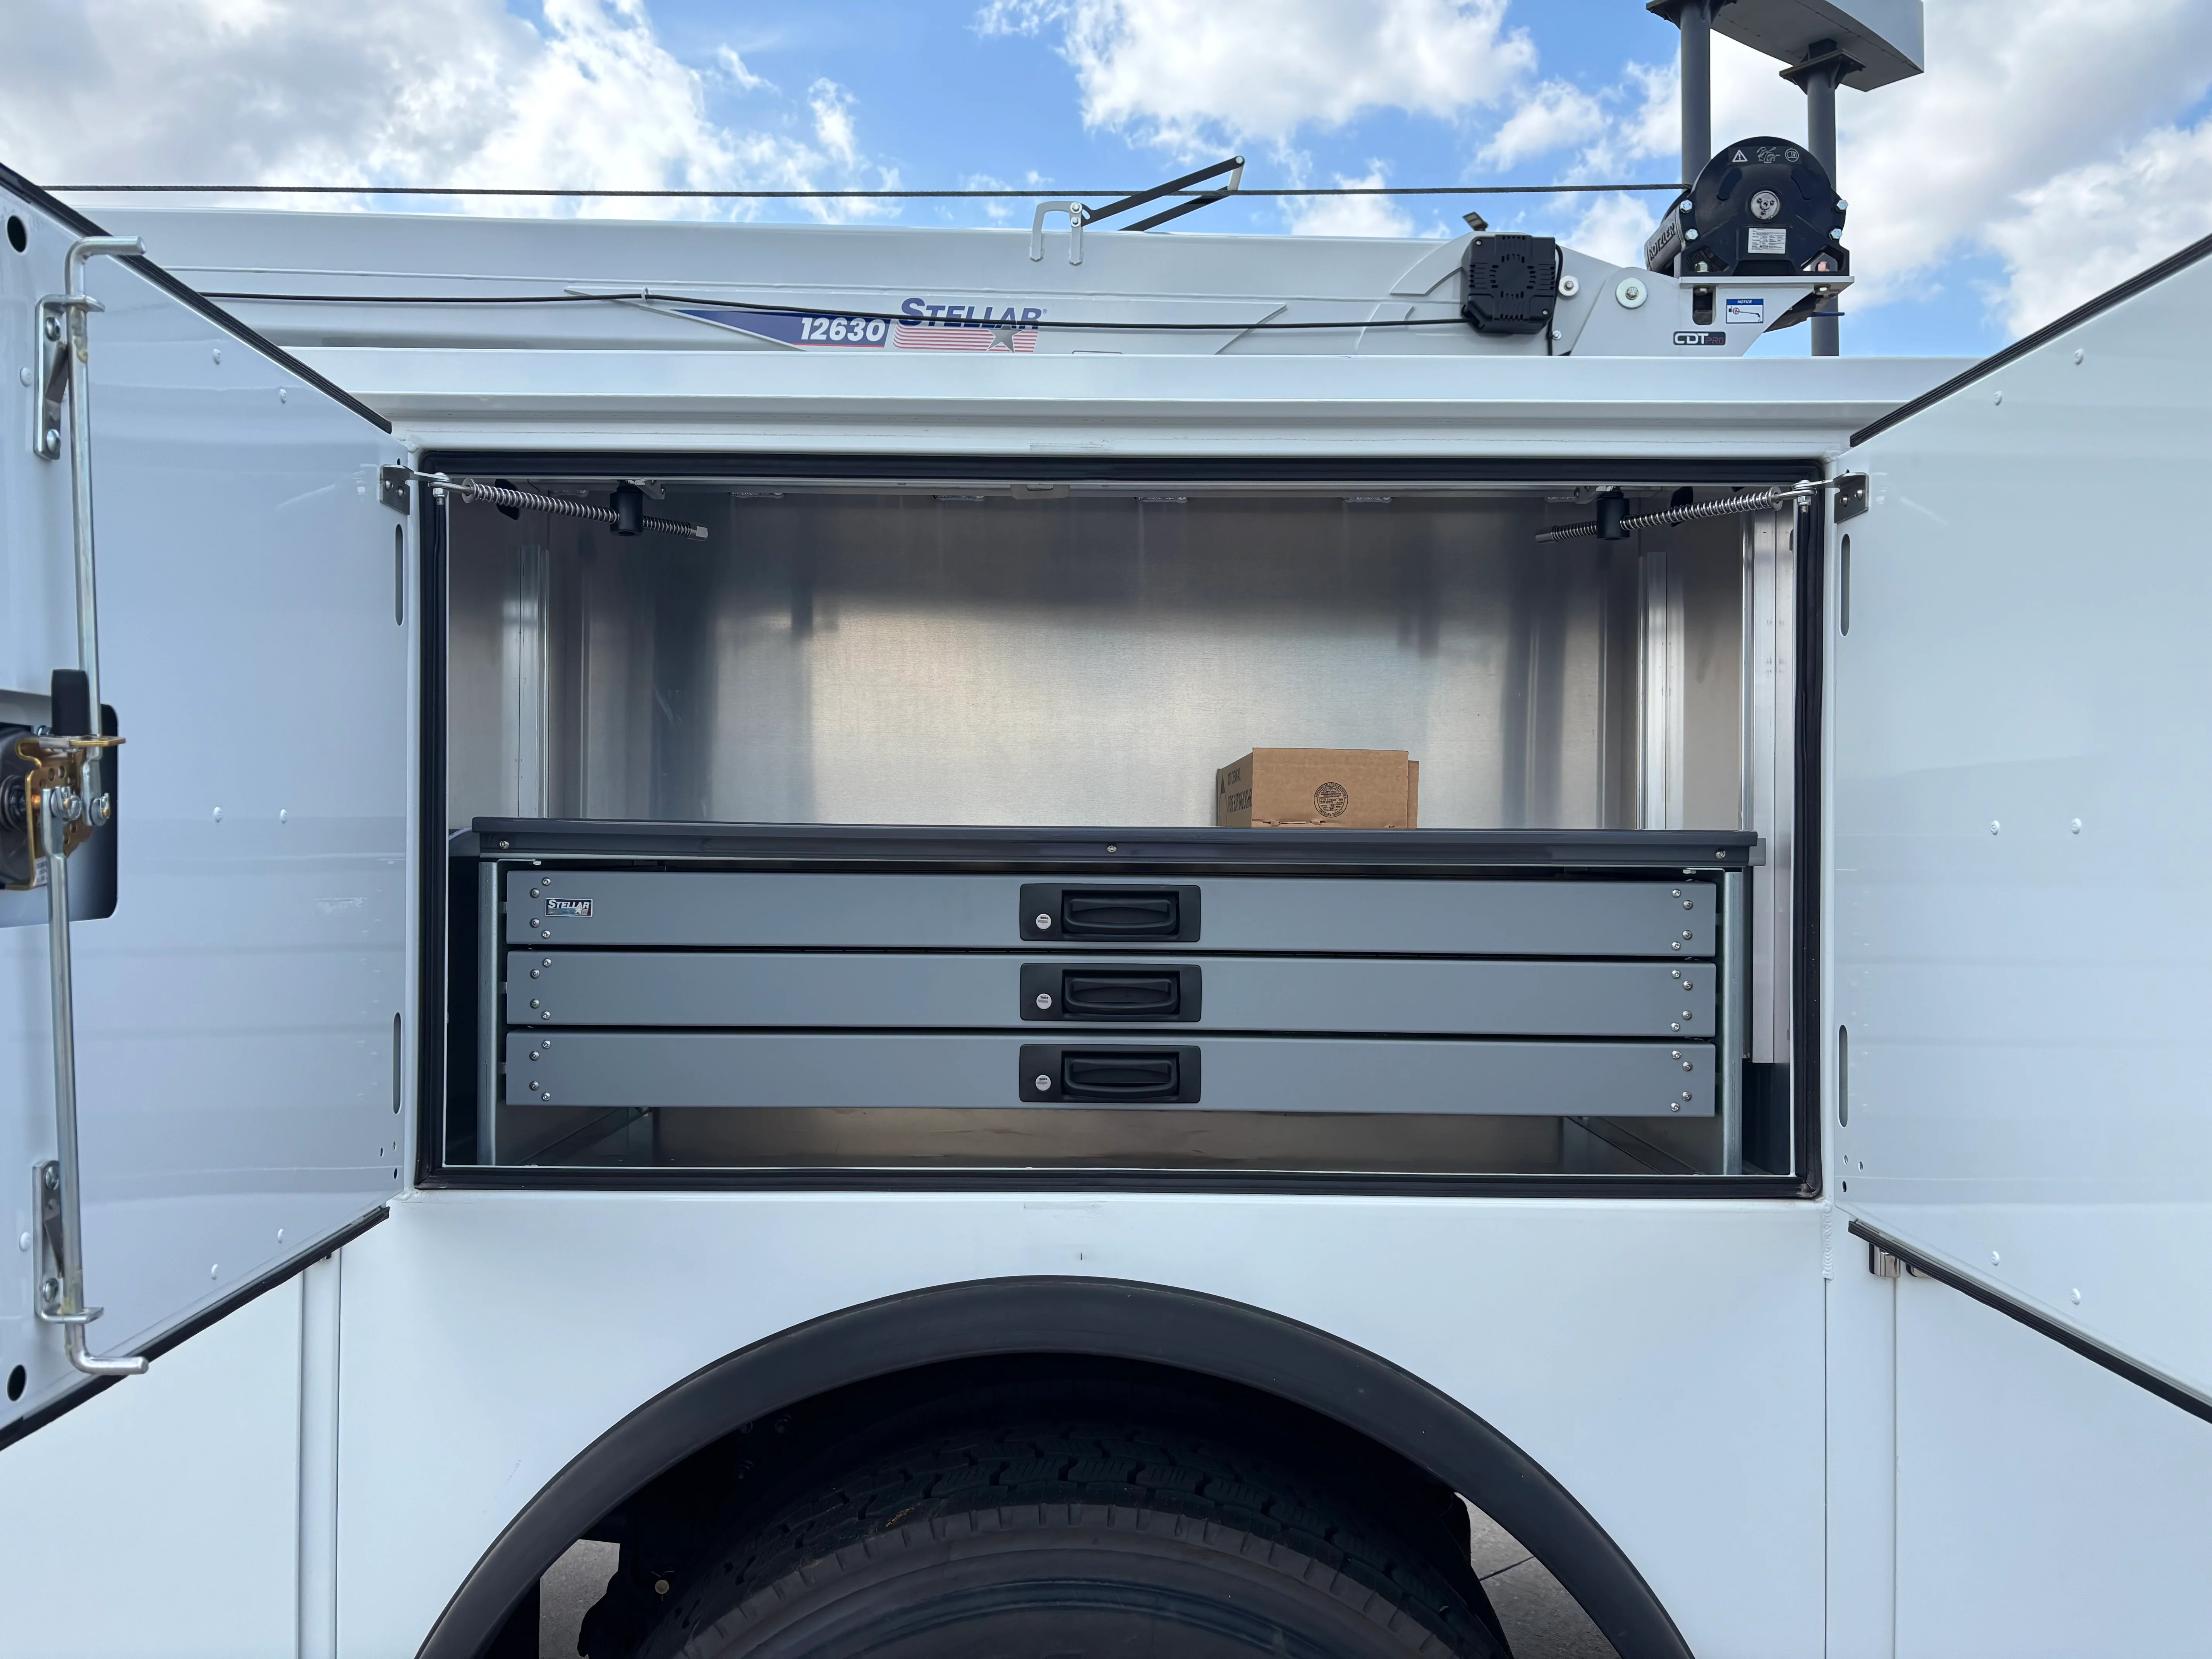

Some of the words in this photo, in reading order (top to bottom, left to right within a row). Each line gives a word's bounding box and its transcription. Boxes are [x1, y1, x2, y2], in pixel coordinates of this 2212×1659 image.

[801, 317, 886, 342] 12630
[1674, 333, 1709, 344] CDT
[548, 899, 590, 909] STELLAR
